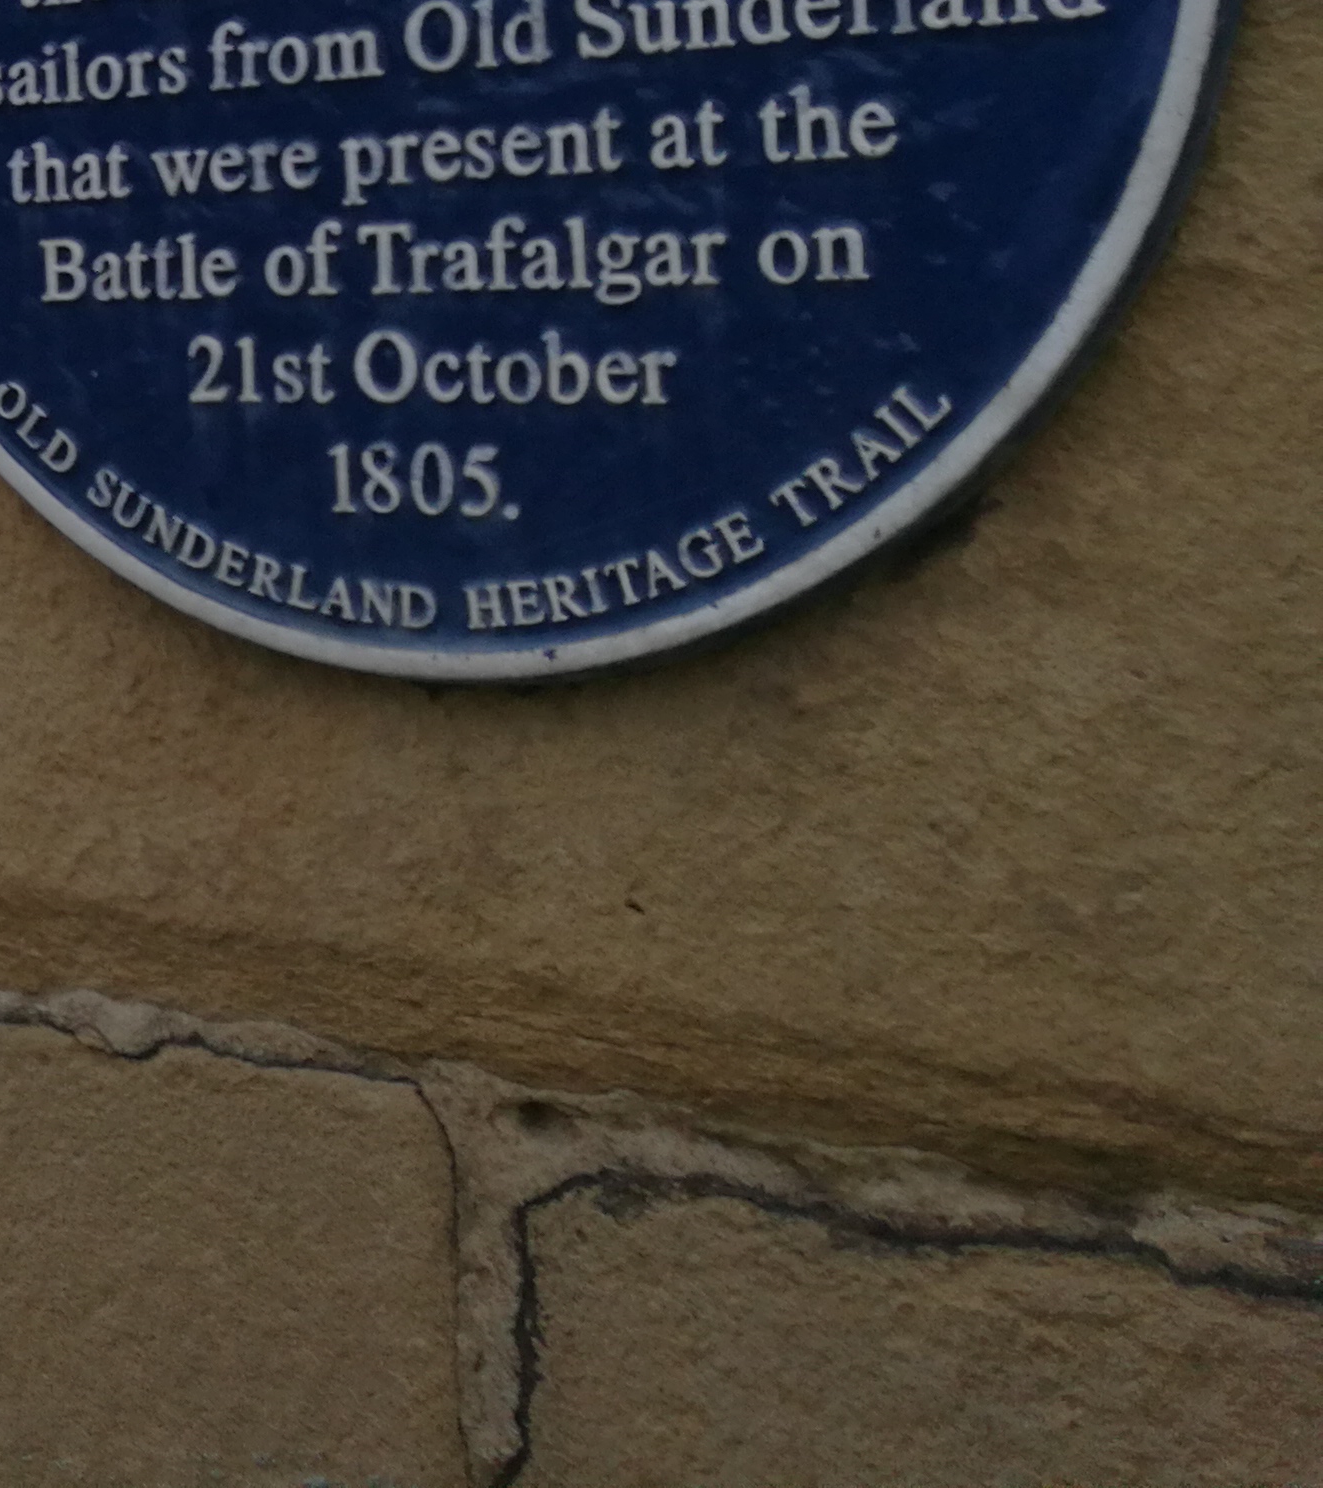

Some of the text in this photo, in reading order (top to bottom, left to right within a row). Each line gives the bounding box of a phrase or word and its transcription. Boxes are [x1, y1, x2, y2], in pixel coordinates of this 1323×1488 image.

[208, 20, 386, 91] from
[7, 83, 899, 207] that were present at the
[38, 215, 871, 306] Battle of Trafalgar on
[187, 329, 678, 405] 21st October
[86, 468, 437, 629] SUNDERLAND
[464, 504, 765, 630] HERITAGE
[769, 386, 952, 527] TRAIL
[328, 442, 520, 521] 1805.
